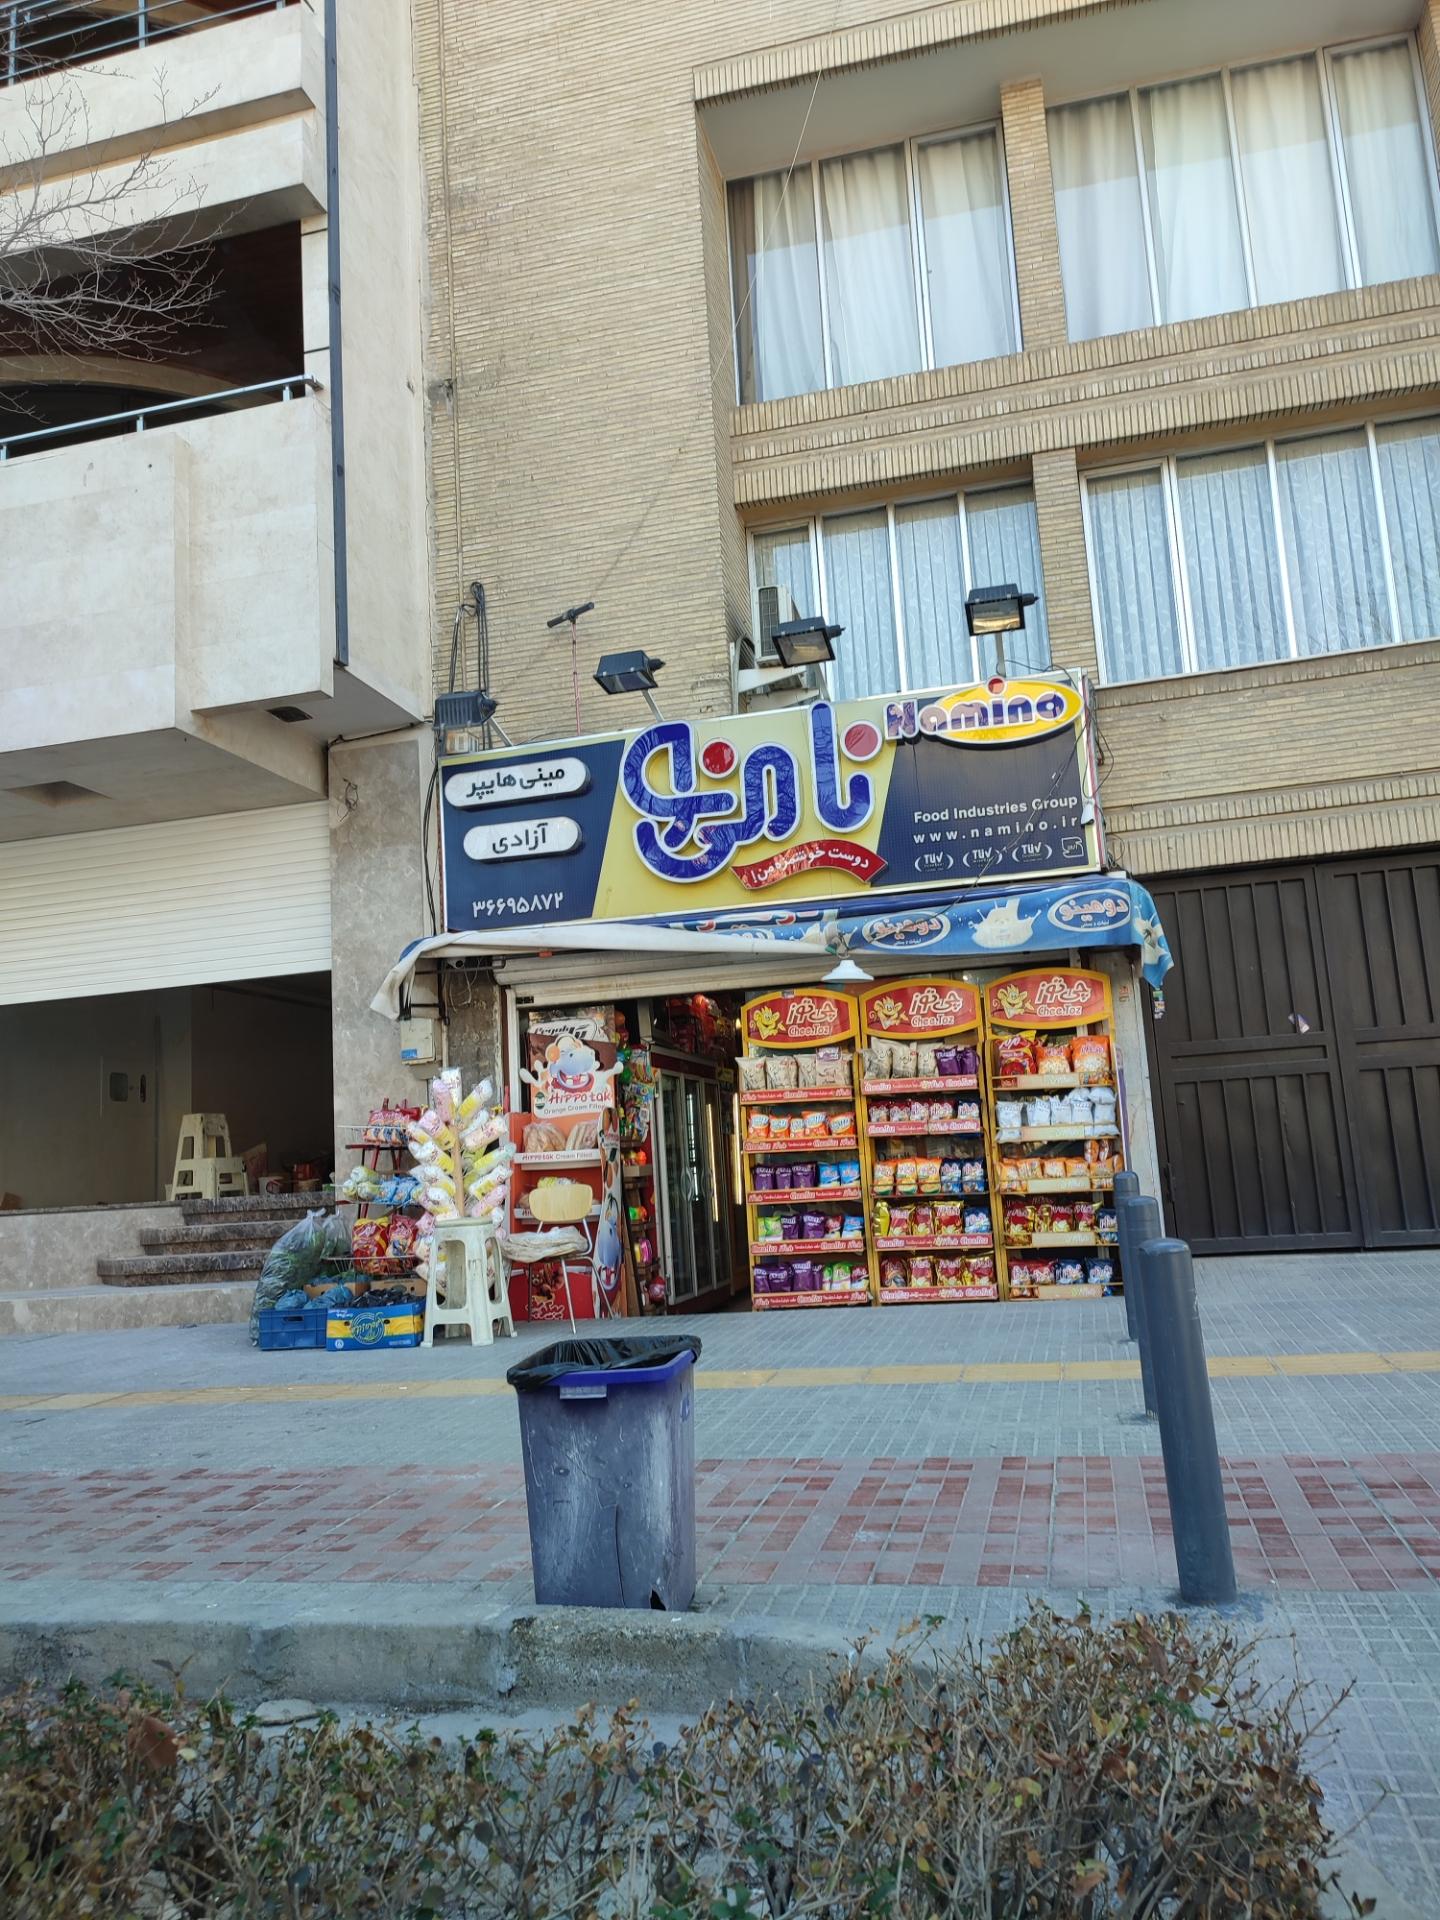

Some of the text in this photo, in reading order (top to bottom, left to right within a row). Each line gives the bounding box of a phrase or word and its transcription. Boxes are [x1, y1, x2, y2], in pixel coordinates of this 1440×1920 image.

[886, 676, 1067, 740] Namino
[466, 767, 565, 800] مینی هایپر
[619, 699, 882, 883] نامینو
[914, 796, 1078, 823] Food Industries Group
[492, 822, 549, 854] آزادی
[828, 847, 869, 868] دوست
[472, 891, 564, 918] ۳۶۶۹۵۸۷۲
[1059, 897, 1129, 922] دومینو
